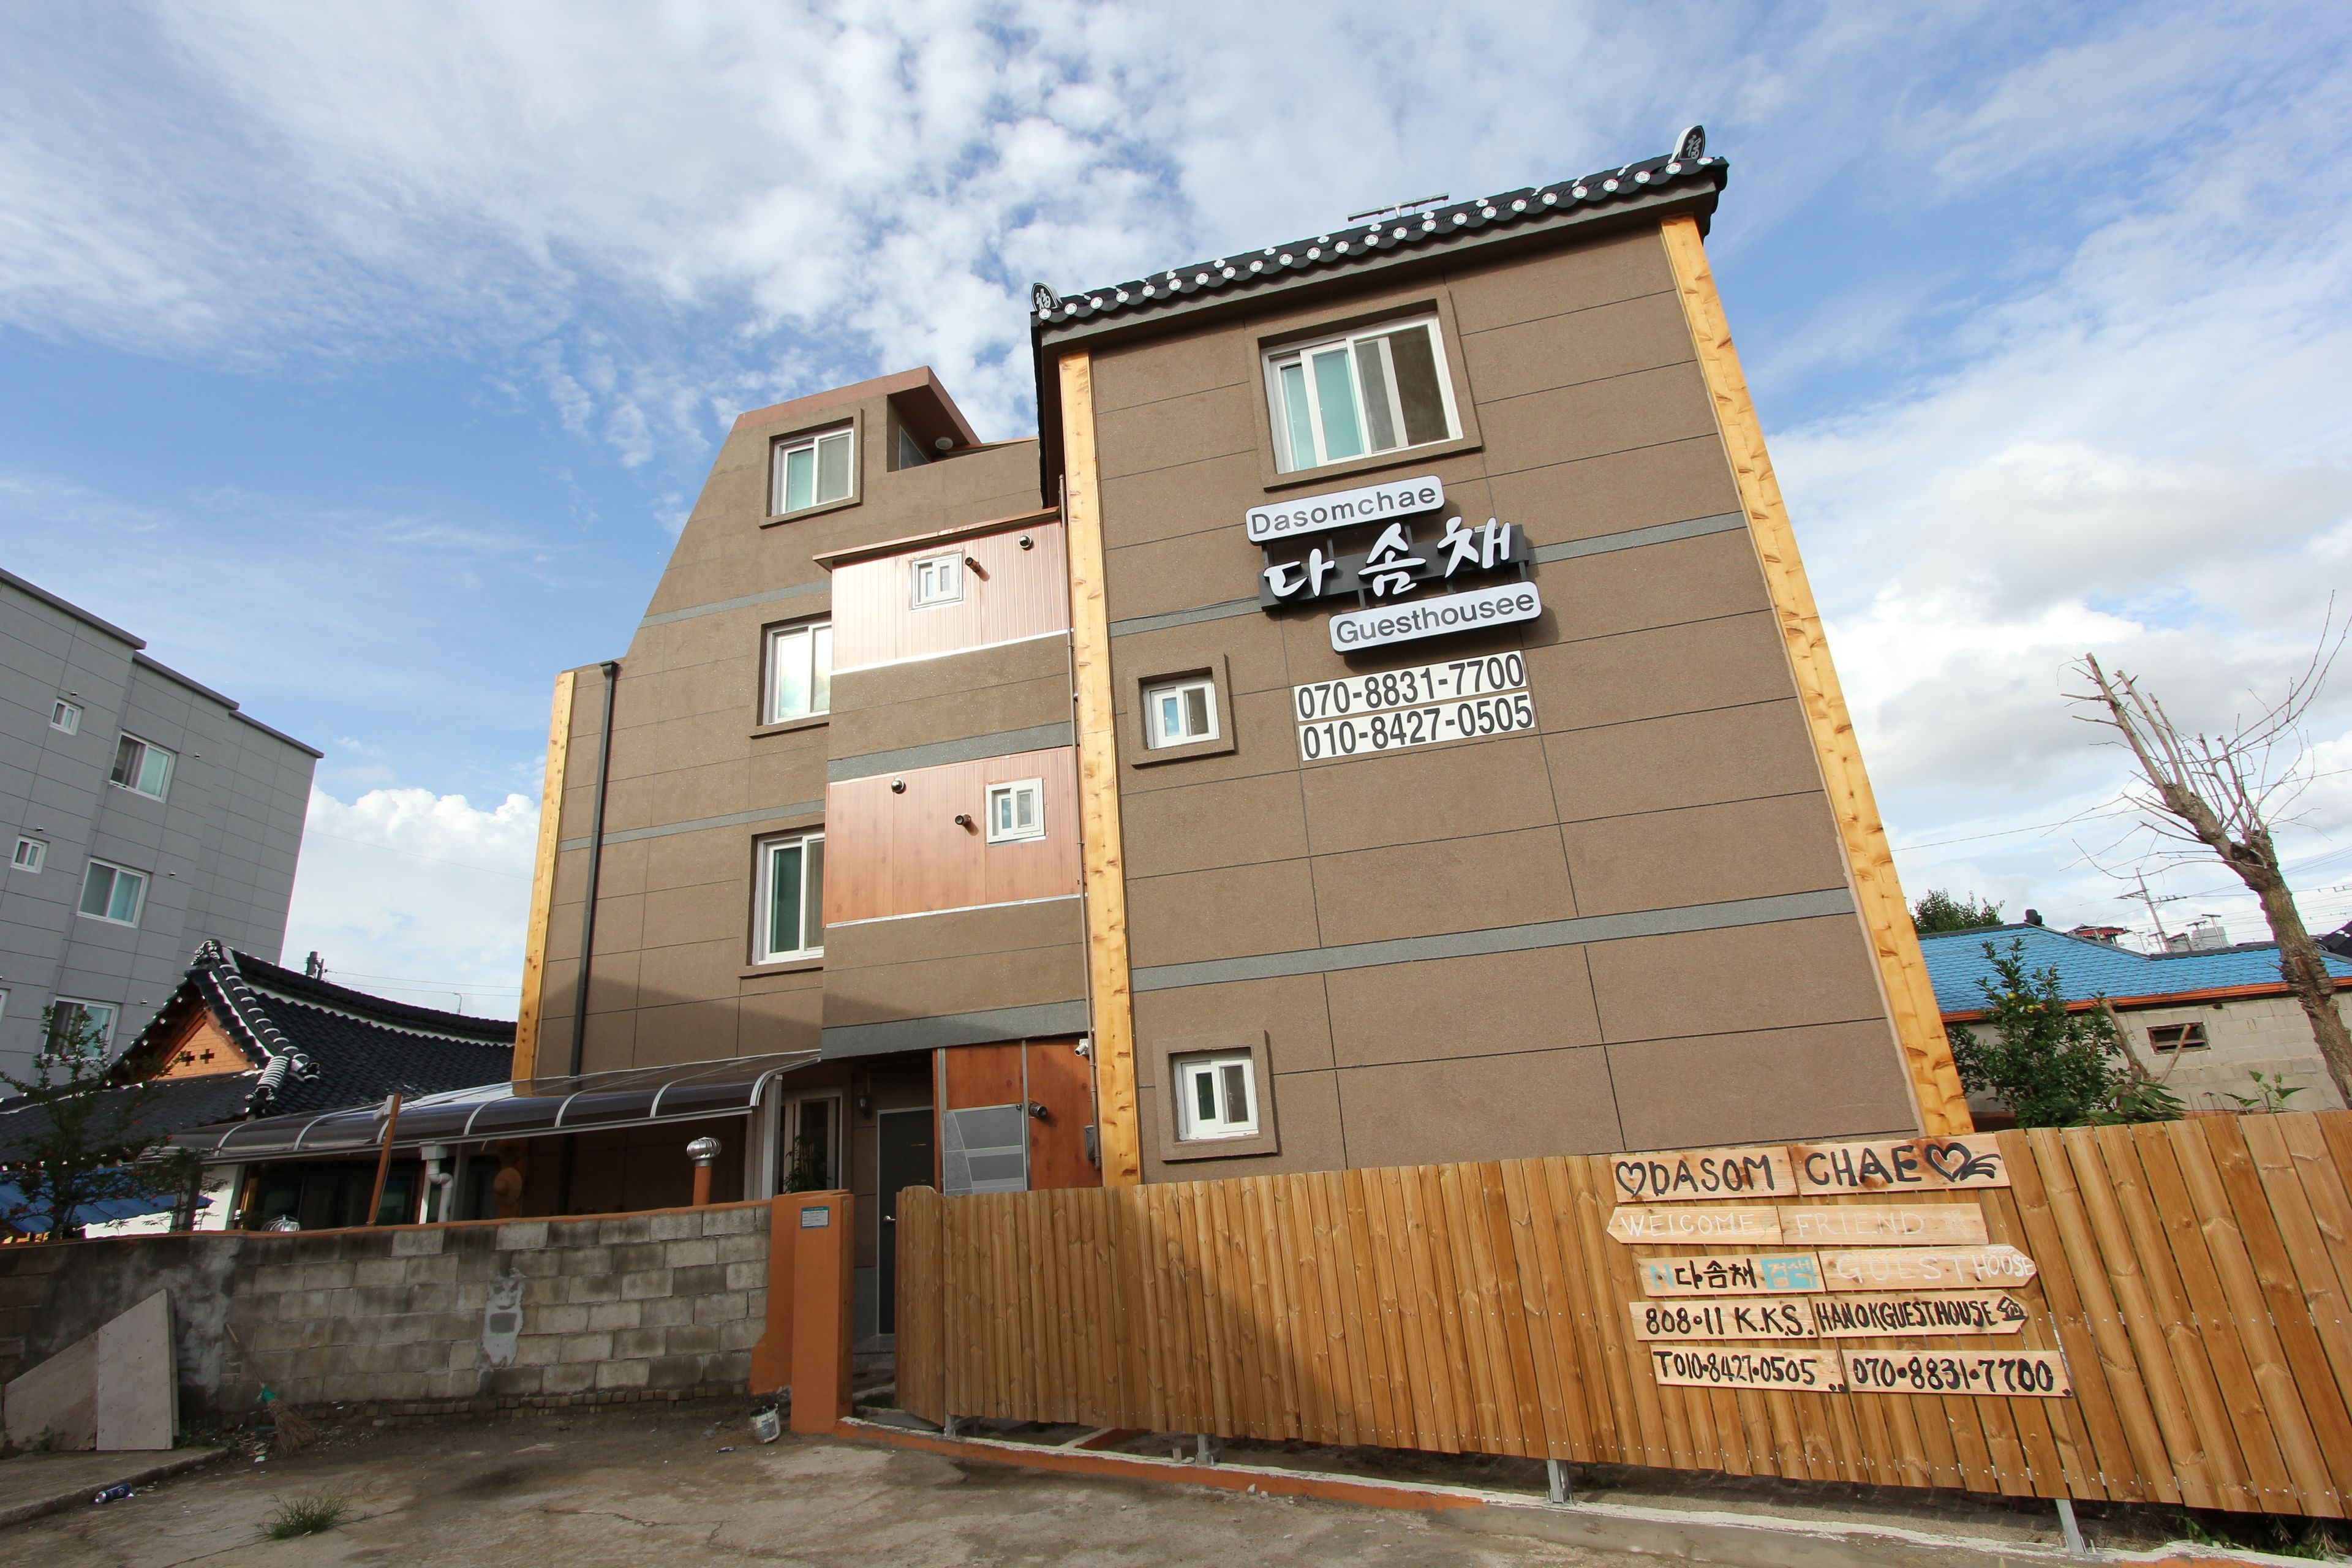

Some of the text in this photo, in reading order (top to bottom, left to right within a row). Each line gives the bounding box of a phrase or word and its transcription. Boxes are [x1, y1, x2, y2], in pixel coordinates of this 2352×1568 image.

[1251, 488, 1436, 535] Dasomchae
[1264, 516, 1511, 597] 다솜채
[1336, 594, 1534, 644] Guesthousee
[1298, 654, 1524, 718] 070-8831-7700
[1303, 695, 1532, 758] 010-8427-0505
[1648, 1145, 1923, 1196] DASOM CHAE
[1795, 1210, 1924, 1237] FRIEND
[1675, 1258, 1757, 1289] 다솜채
[1766, 1259, 1815, 1288] 검색
